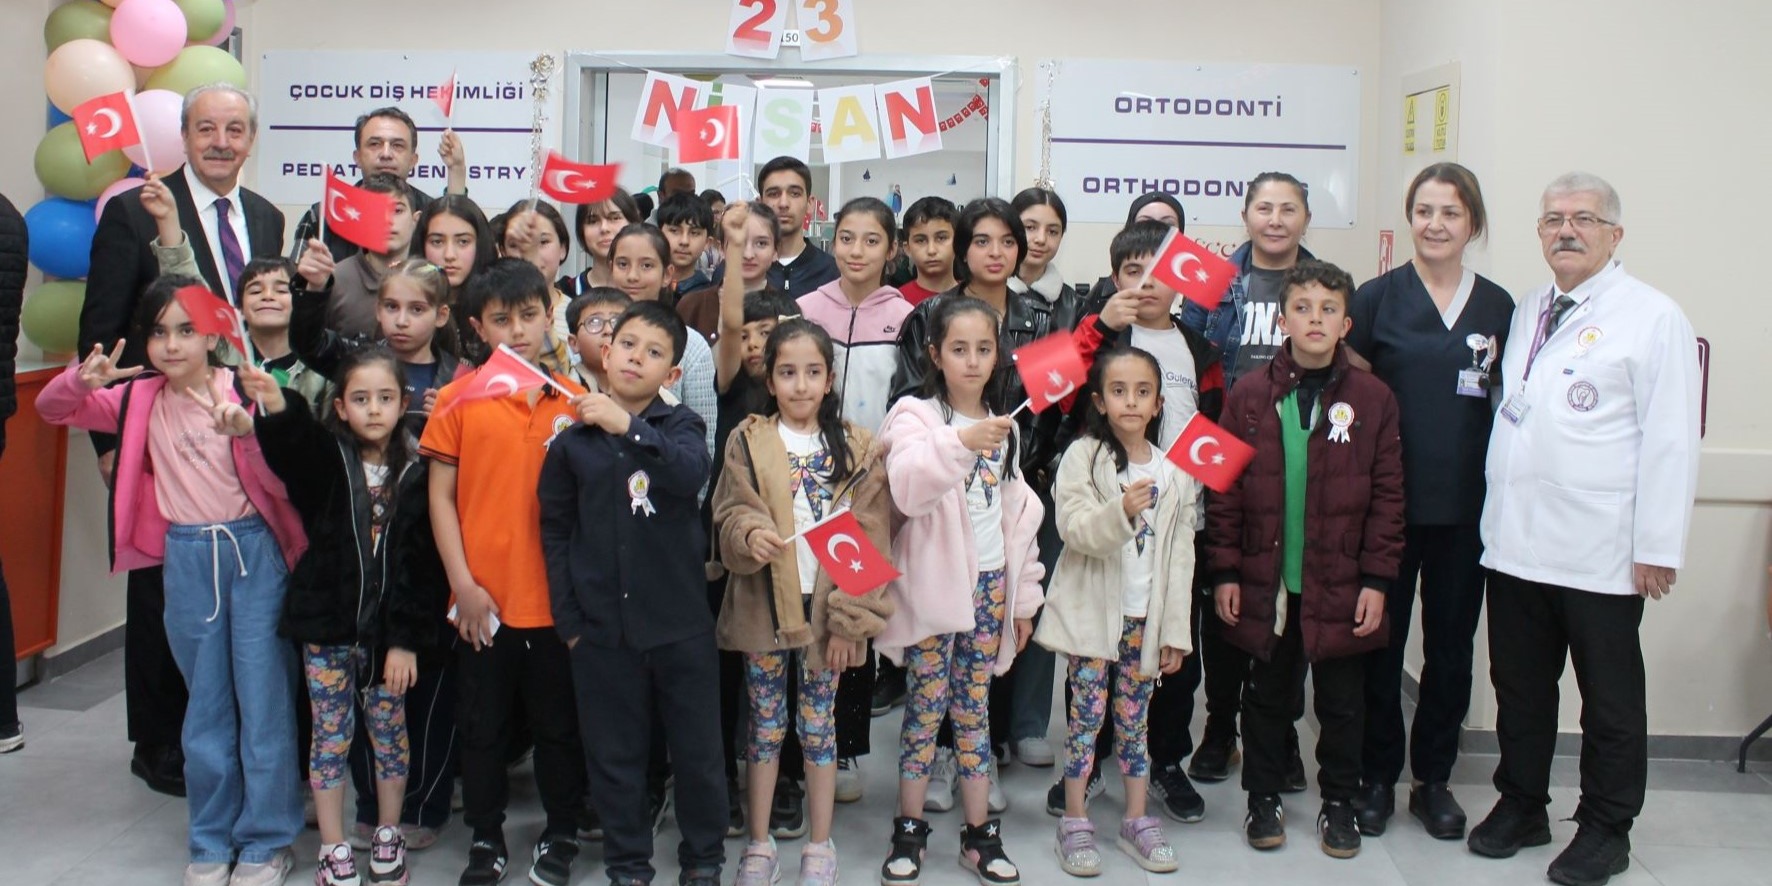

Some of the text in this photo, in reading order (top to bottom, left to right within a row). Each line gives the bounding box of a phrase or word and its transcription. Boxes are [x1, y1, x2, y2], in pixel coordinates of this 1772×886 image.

[289, 84, 364, 101] ÇOCUK
[370, 81, 404, 101] DİŞ
[1114, 95, 1282, 117] ORTODONTİ
